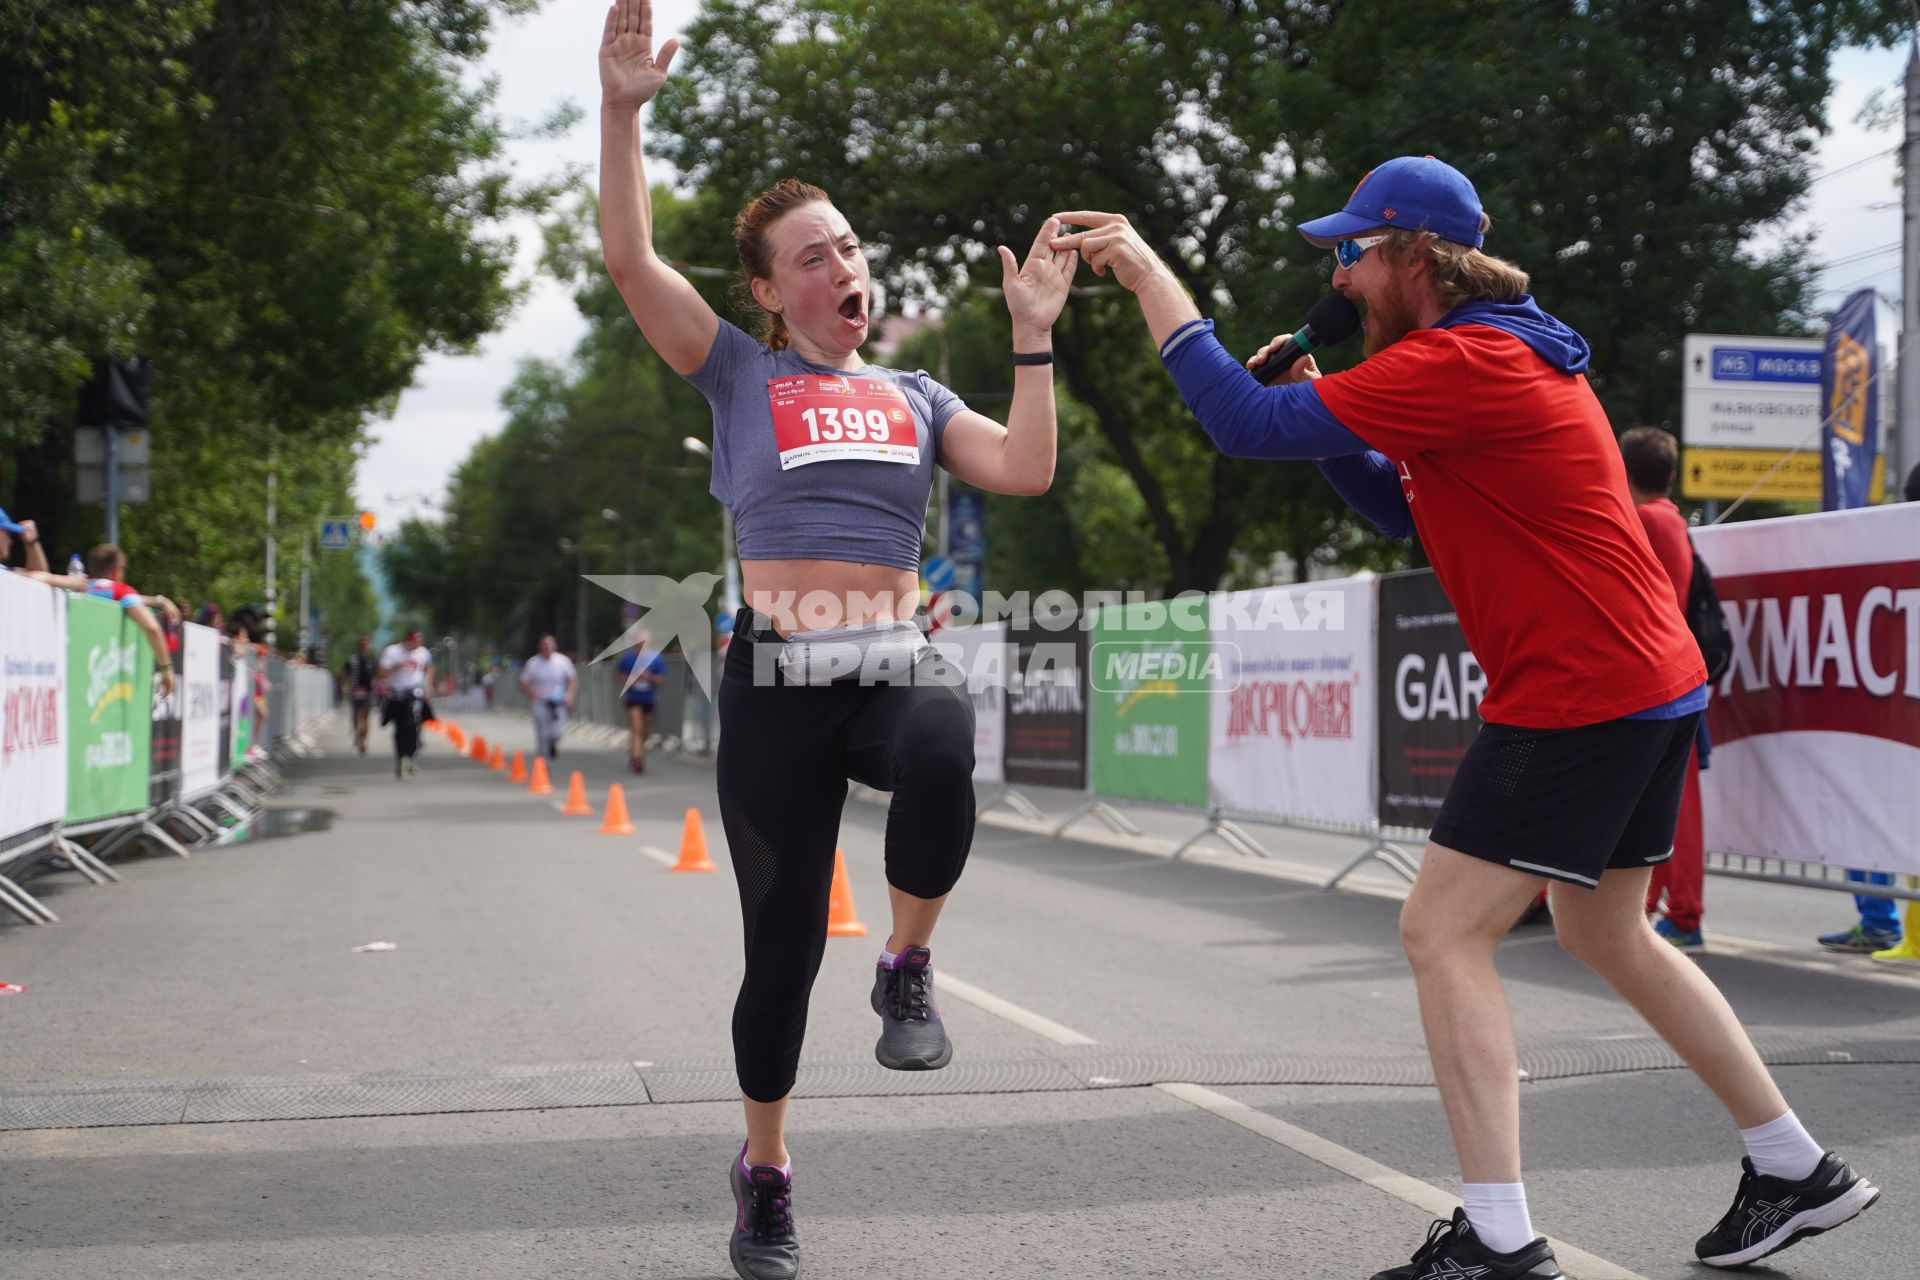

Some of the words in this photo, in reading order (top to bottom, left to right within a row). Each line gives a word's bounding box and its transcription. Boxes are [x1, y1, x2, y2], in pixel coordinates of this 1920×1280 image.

[801, 407, 890, 442] 1399
[893, 411, 903, 420] E
[1707, 585, 1920, 704] ХМАСТ
